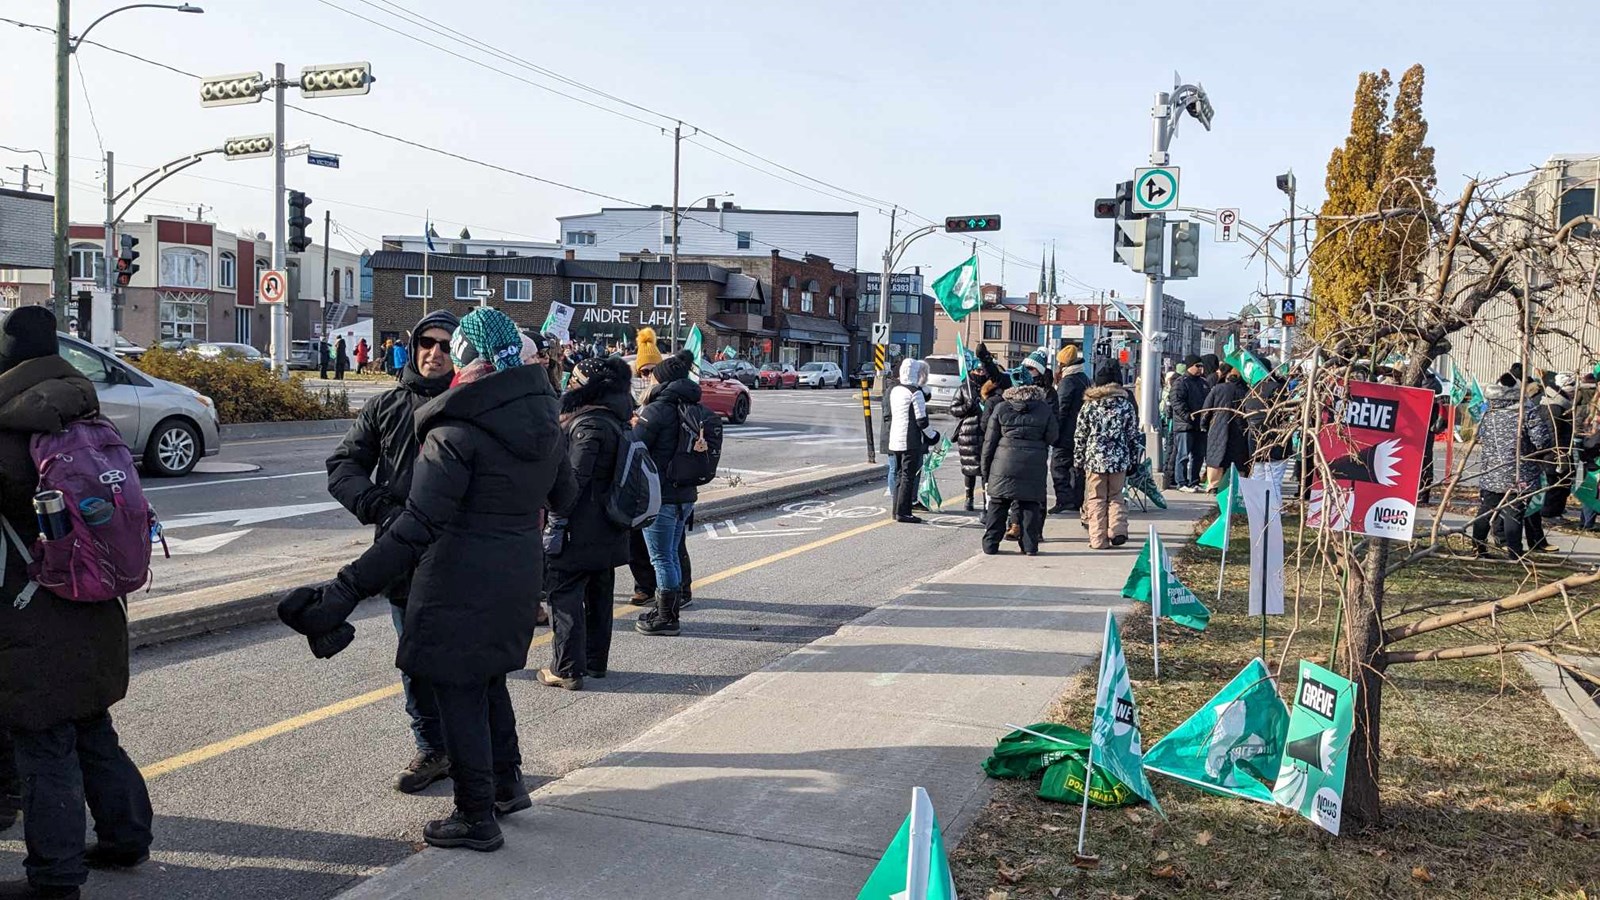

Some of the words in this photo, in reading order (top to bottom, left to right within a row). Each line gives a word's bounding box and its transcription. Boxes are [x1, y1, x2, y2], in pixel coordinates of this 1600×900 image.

[582, 308, 630, 324] ANDRE
[640, 311, 687, 326] LAHAE
[1373, 506, 1408, 526] NOUS
[1301, 681, 1335, 718] GRÈVE
[1067, 778, 1114, 803] DOLARAMA
[1316, 794, 1338, 819] NOUS
